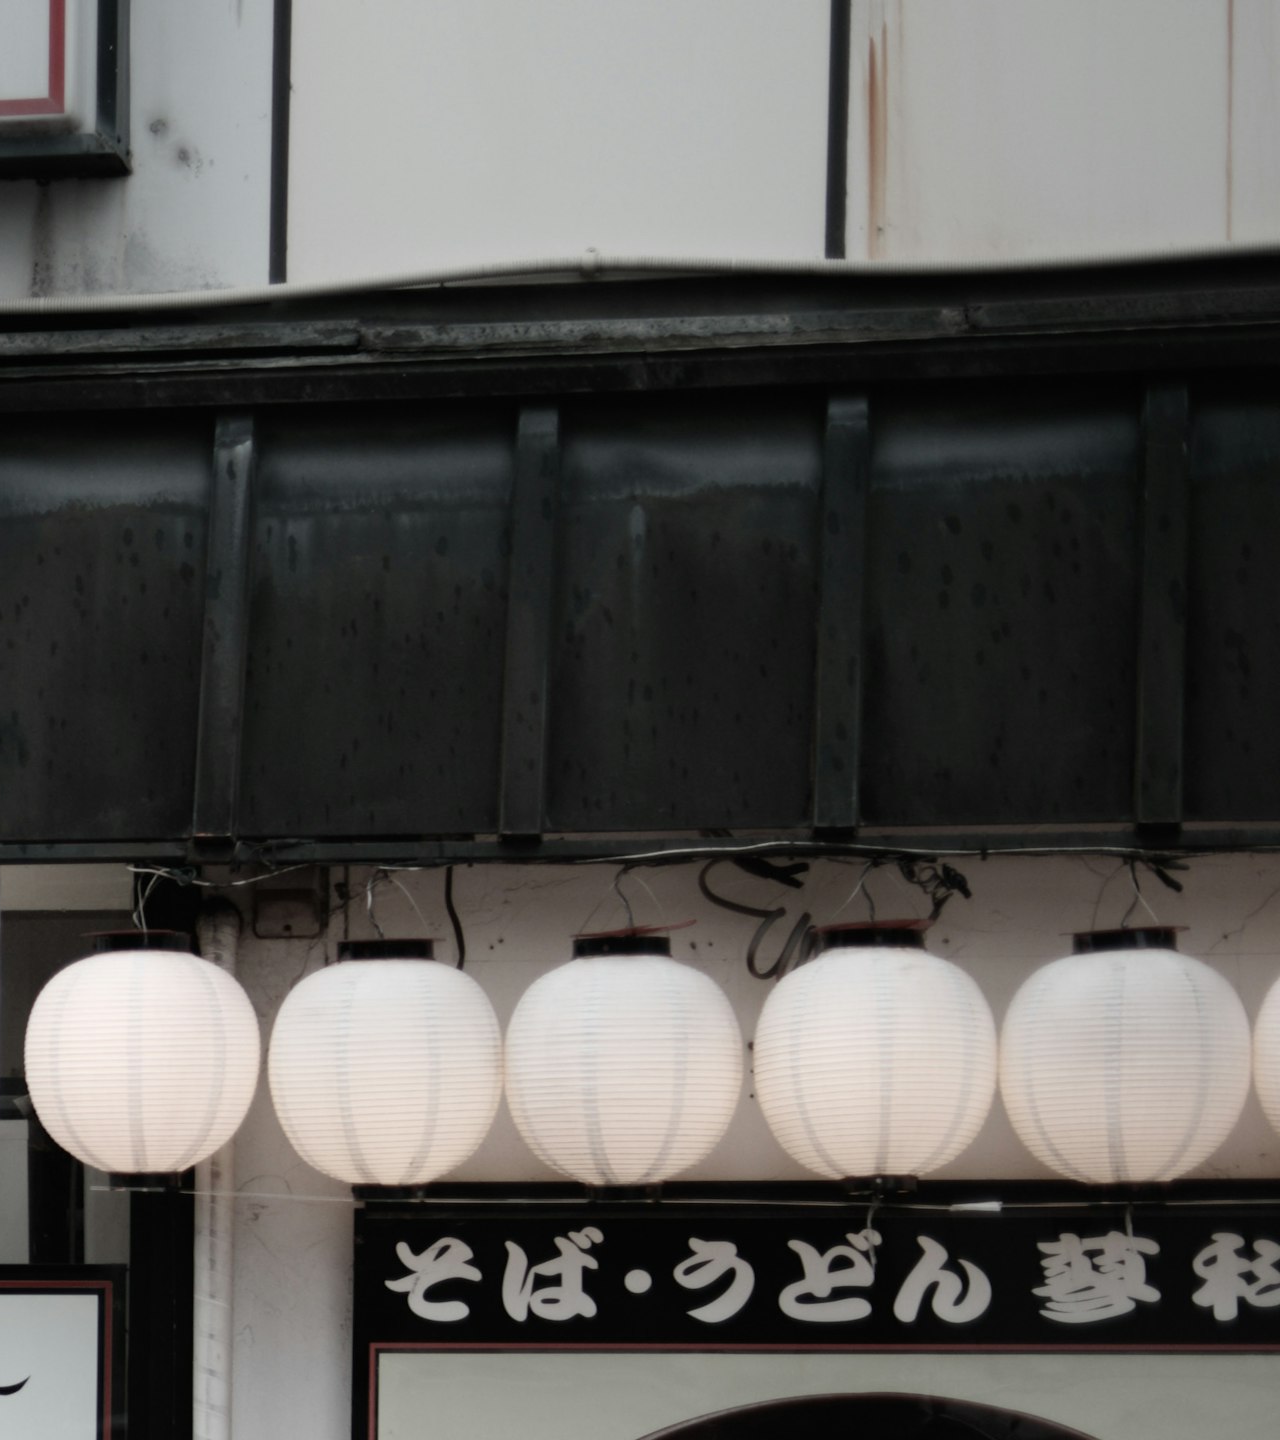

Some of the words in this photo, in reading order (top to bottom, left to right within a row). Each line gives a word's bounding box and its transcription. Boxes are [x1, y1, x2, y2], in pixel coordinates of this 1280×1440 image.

[385, 1227, 993, 1323] そば・うどん
